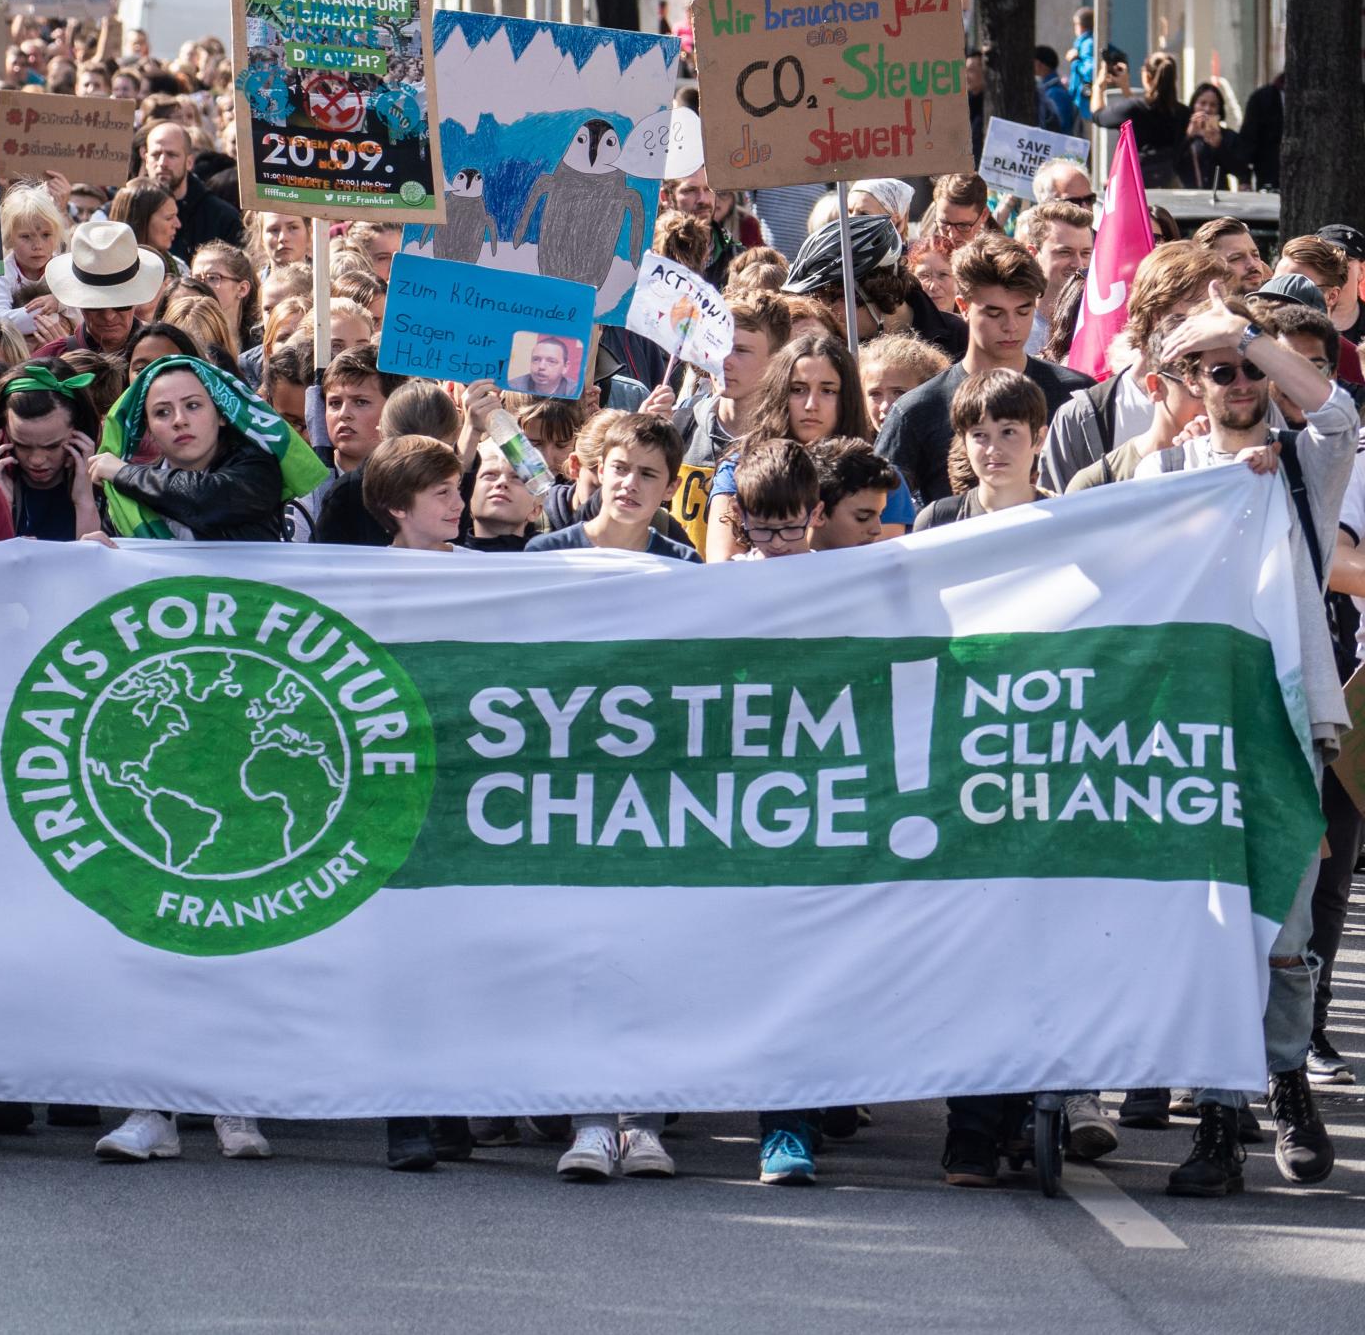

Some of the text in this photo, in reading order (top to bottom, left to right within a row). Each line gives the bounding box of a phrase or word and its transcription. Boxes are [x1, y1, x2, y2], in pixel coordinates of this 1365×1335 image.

[806, 26, 849, 48] eine
[728, 124, 773, 169] die
[1016, 138, 1052, 156] SAVE
[1021, 150, 1047, 166] THE
[336, 194, 394, 206] FFF_Frankfurt
[651, 264, 688, 291] ACT
[450, 281, 578, 323] Klimawandel
[393, 313, 497, 348] Sagen wir
[395, 339, 442, 371] Halt
[962, 666, 1096, 720] NOT
[15, 591, 416, 873] FRIDAYS FOR FUTURE
[466, 681, 862, 760] SYSTEM
[466, 765, 869, 850] CHANGE
[959, 771, 1246, 831] CHANGE
[156, 840, 370, 929] FRANKFURT
